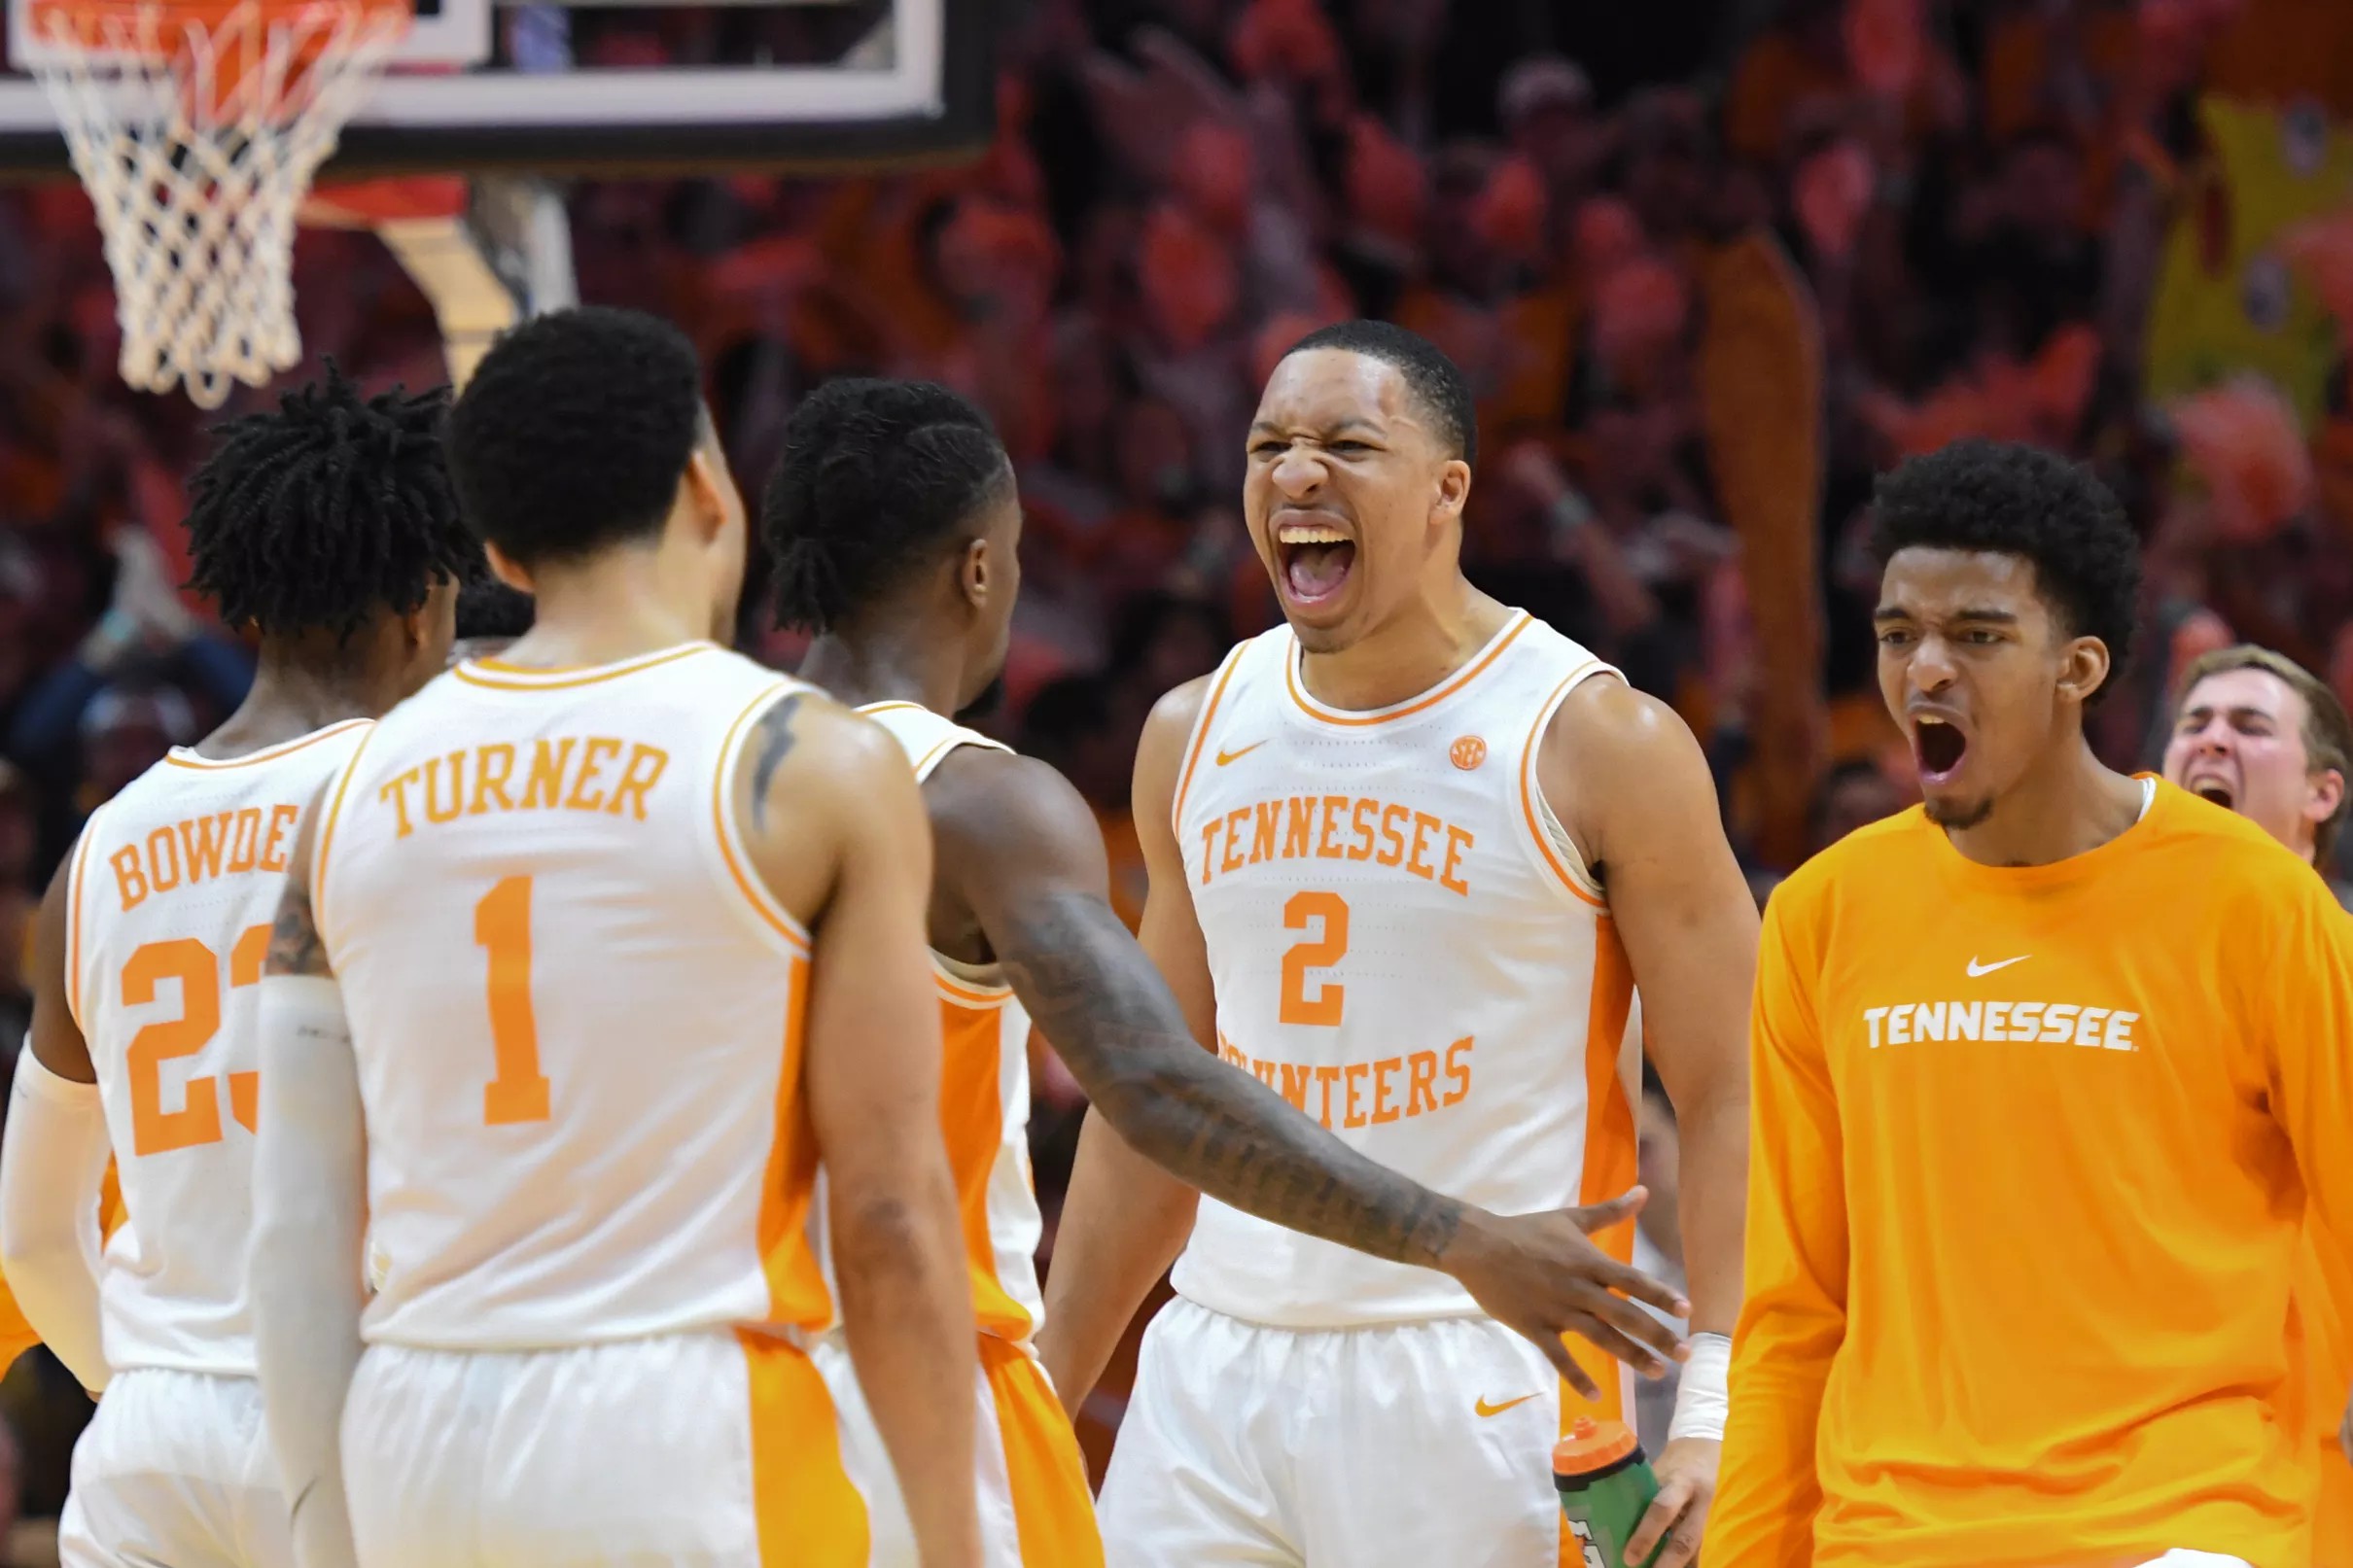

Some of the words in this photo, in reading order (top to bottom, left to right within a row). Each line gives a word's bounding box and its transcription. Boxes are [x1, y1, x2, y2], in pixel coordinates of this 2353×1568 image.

[380, 737, 670, 839] TURNER
[1201, 795, 1474, 897] TENNESSEE
[474, 875, 551, 1126] 1
[1279, 890, 1350, 1027] 2
[1863, 1001, 2140, 1051] TENNESSEE
[1219, 1030, 1475, 1132] NTEERS
